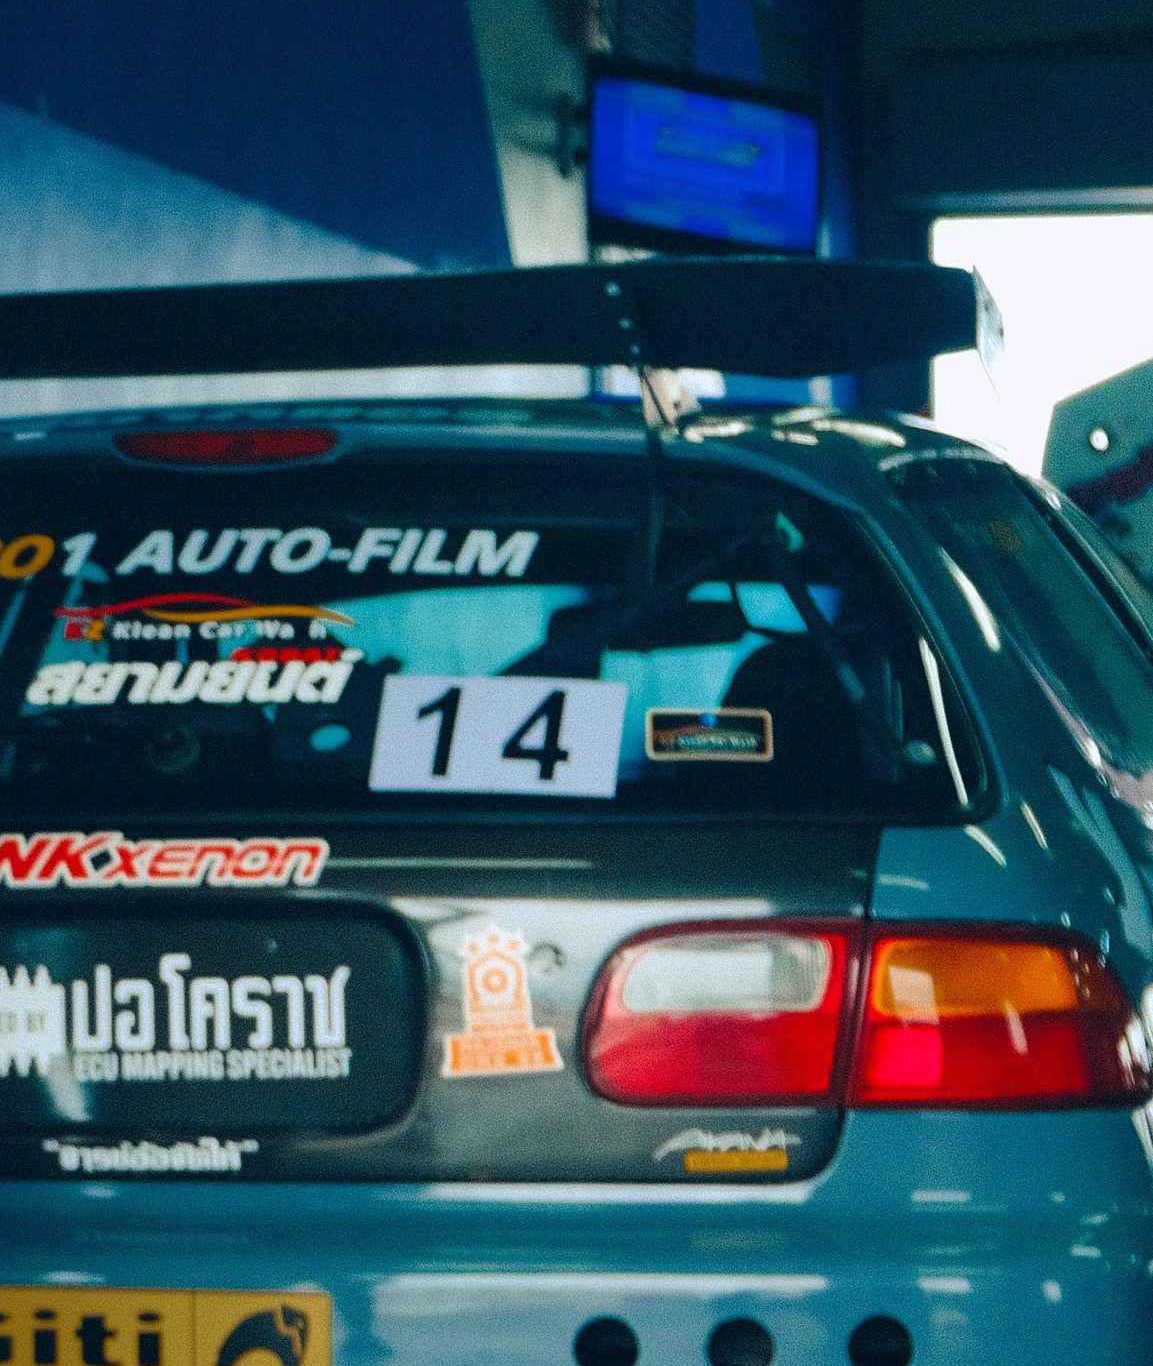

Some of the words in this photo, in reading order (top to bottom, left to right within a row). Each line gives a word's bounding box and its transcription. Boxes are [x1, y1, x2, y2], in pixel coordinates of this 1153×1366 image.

[118, 528, 538, 576] AUTO-FILM
[252, 619, 327, 641] Wah
[25, 1011, 48, 1033] BY
[75, 1050, 119, 1081] ECU
[122, 1049, 225, 1080] MAPPING
[226, 1047, 352, 1078] SPECIALIST
